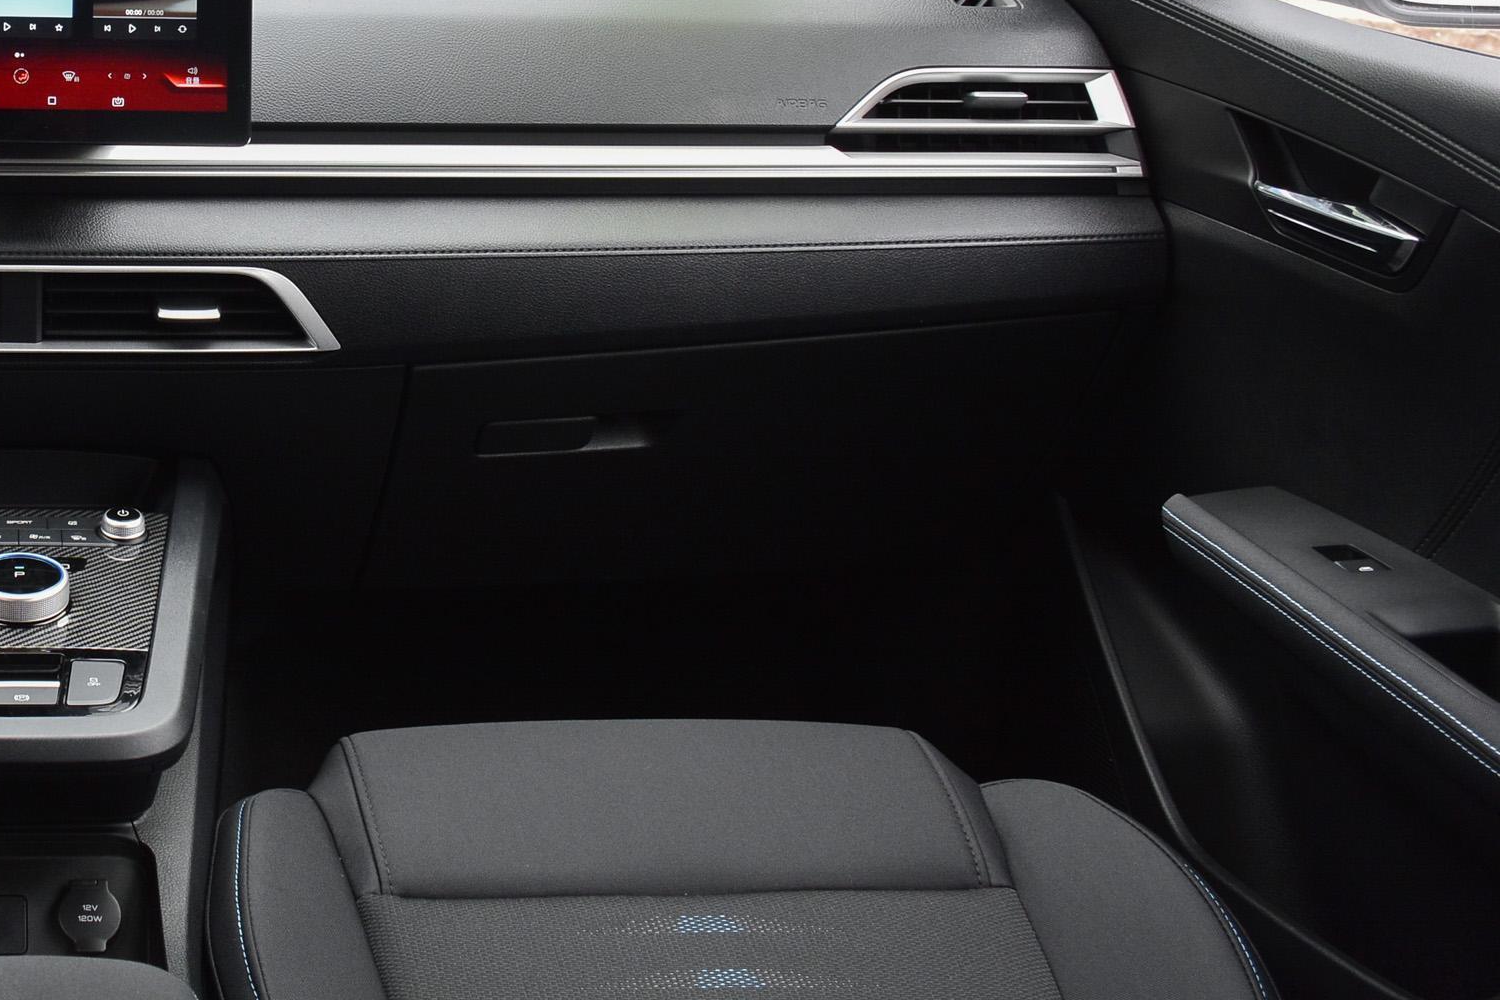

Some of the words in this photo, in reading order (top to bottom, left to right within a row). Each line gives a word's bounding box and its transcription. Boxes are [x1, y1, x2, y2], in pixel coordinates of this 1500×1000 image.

[777, 97, 828, 109] AIRBAG
[82, 904, 98, 912] 12V
[78, 914, 103, 922] 120W
